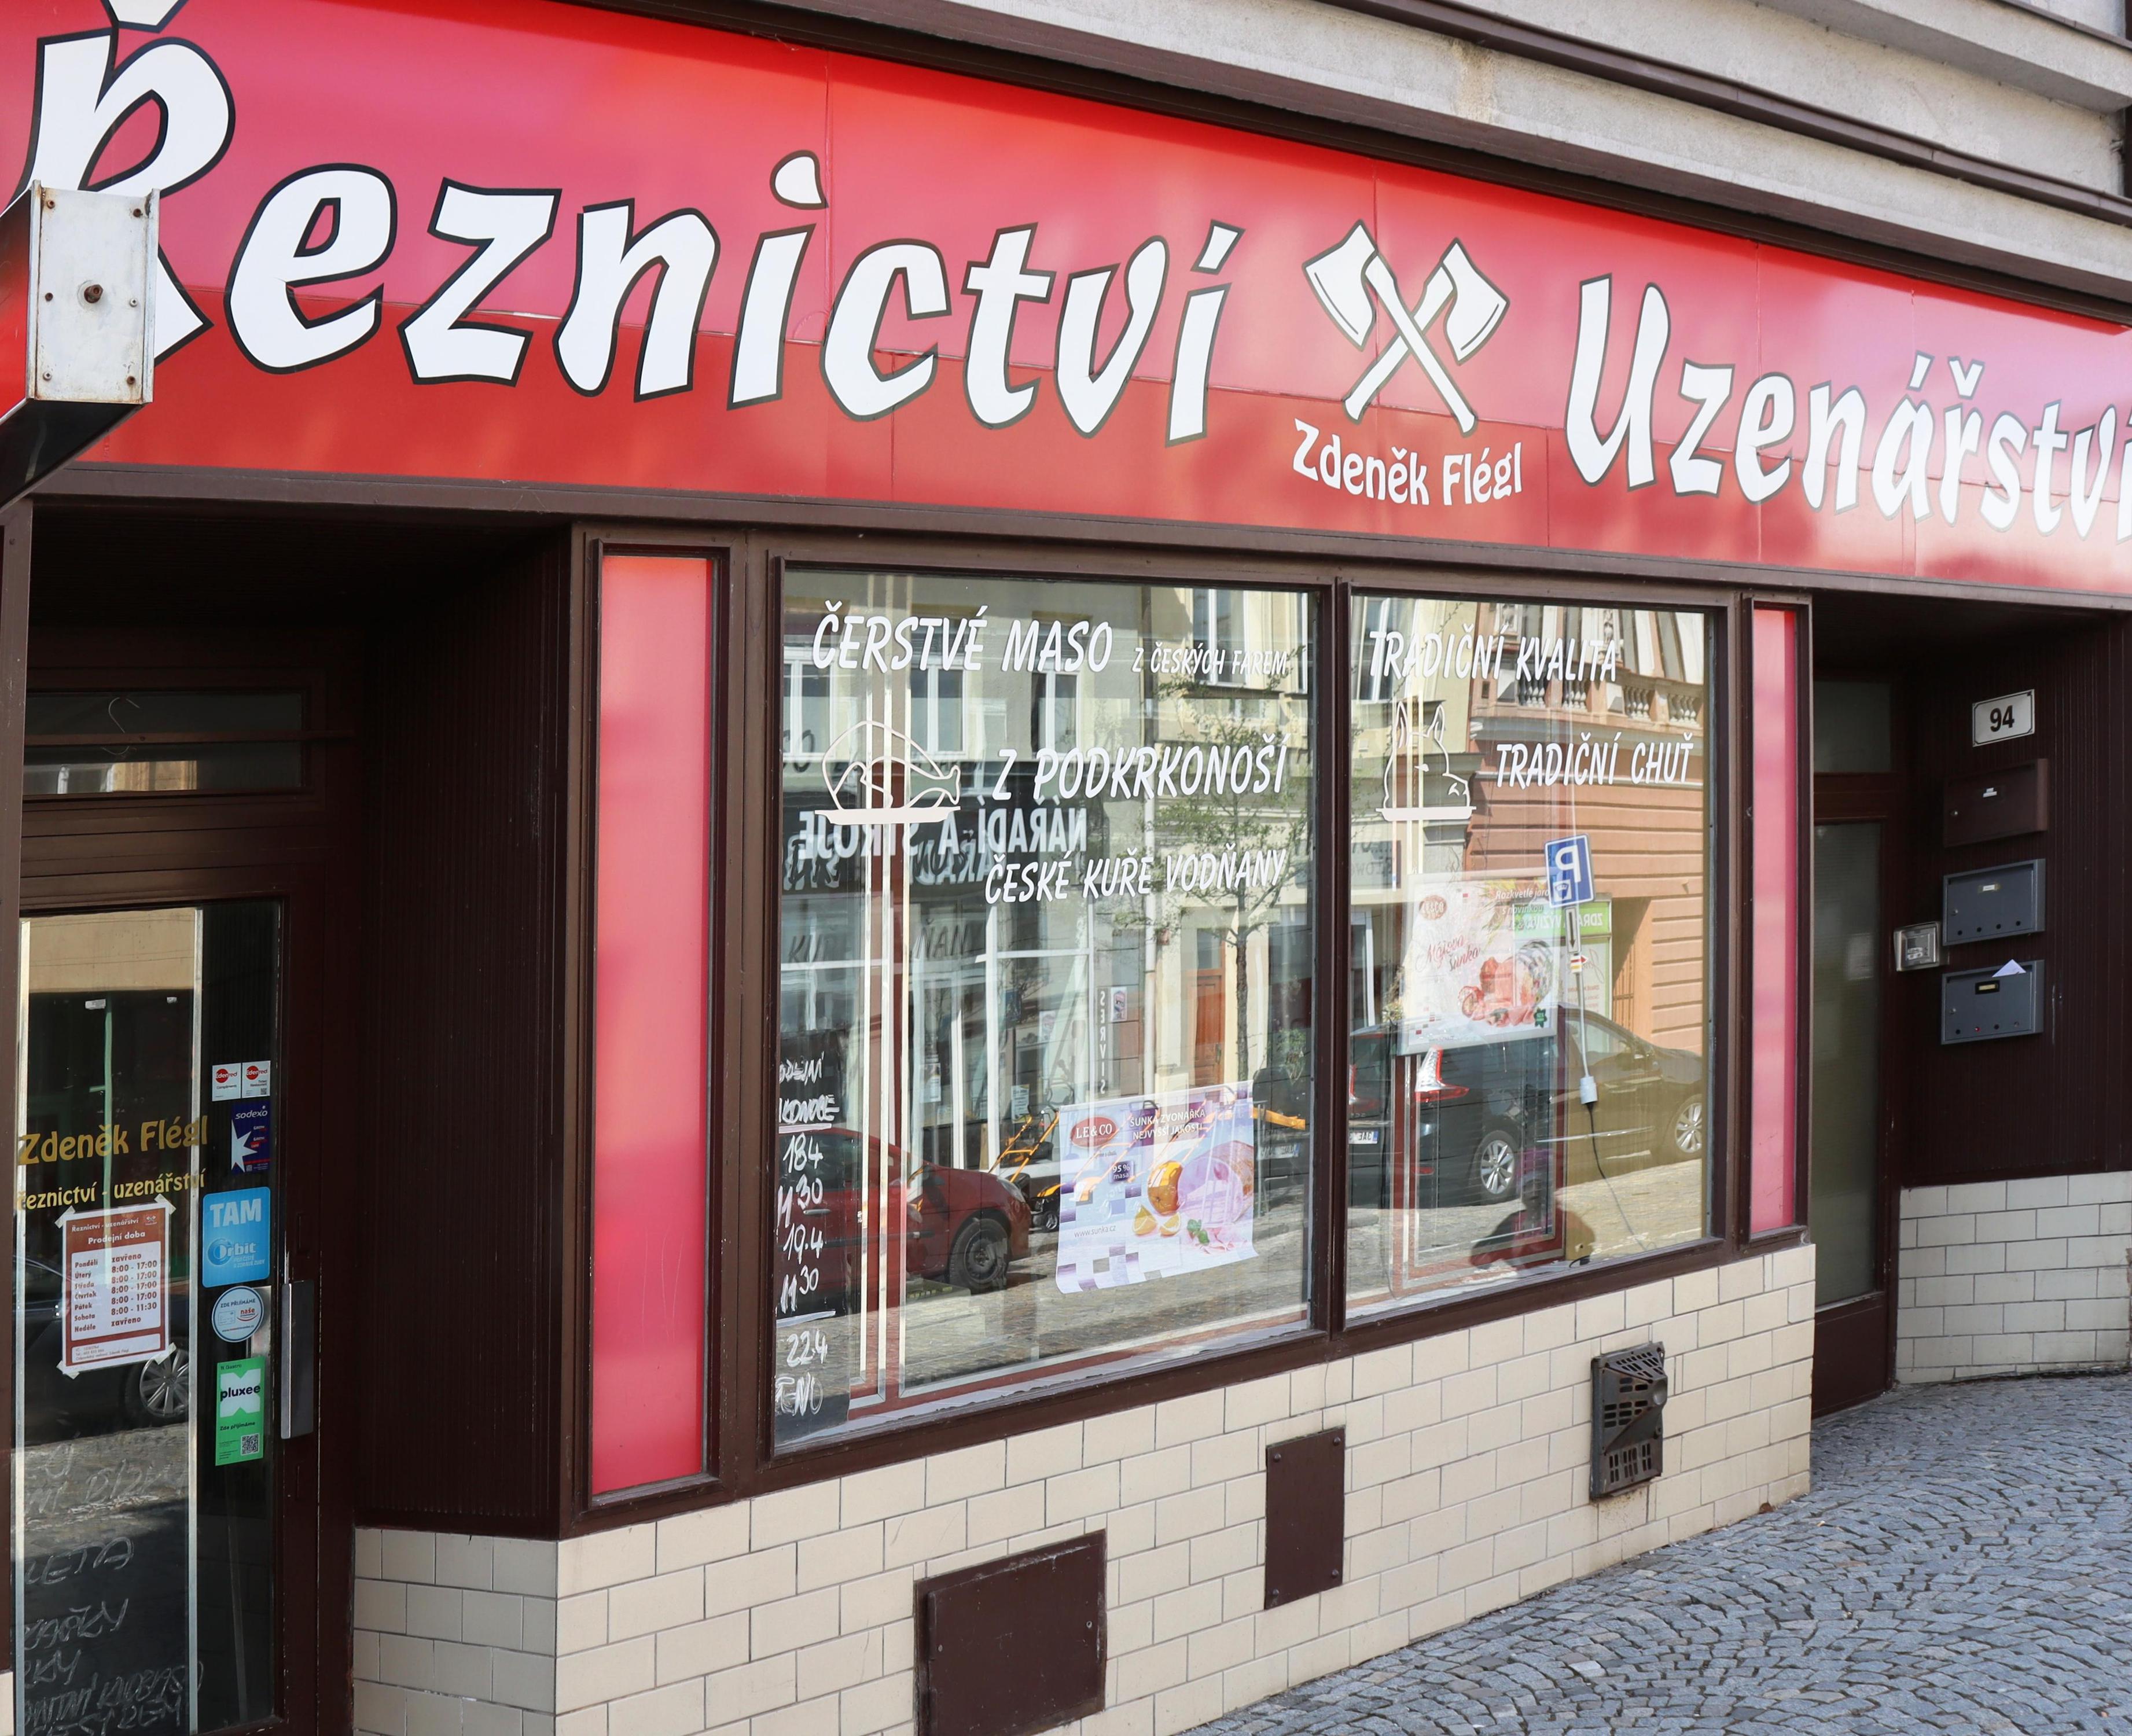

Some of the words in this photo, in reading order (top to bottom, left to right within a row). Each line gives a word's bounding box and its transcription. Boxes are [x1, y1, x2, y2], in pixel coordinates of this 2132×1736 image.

[0, 0, 1245, 447] Řeznictví
[1292, 418, 1429, 506] Zdeněk
[1443, 442, 1522, 506] Flégl
[812, 600, 988, 673] ČERSTVÉ
[1002, 620, 1113, 673] MASO
[1131, 647, 1145, 673] Z
[1150, 641, 1226, 675] ČESKÝCH
[1232, 650, 1288, 675] FAREM
[1369, 624, 1509, 680] TRADIČNÍ
[1516, 637, 1623, 682] KVALITA
[1990, 705, 2015, 733] 94
[992, 749, 1017, 801] Z
[1033, 733, 1292, 801] PODKRKONOŠÍ
[1496, 732, 1621, 789] TRADIČNÍ
[1631, 732, 1694, 784] CHUŤ
[985, 851, 1073, 904] ČESKÉ
[1082, 847, 1152, 900] KUŘE
[1164, 843, 1287, 893] VODŇANY
[1495, 888, 1532, 899] Rozkvetlé
[215, 1071, 237, 1079] Edenred
[235, 1106, 268, 1120] sodexo
[1130, 1115, 1158, 1128] ŠUNKA
[1160, 1109, 1205, 1123] ZVONAŘKA
[18, 1124, 128, 1165] Zdeněk
[141, 1116, 207, 1152] Flégl
[114, 1168, 206, 1199] uzenářství
[209, 1198, 262, 1227] TAM
[72, 1223, 101, 1232] Řeznictví
[88, 1233, 122, 1244] Prodejní
[124, 1231, 145, 1240] doba
[75, 1259, 98, 1268] Pondělí
[112, 1253, 141, 1263] zavřeno
[208, 1238, 256, 1266] Orbit
[75, 1271, 91, 1279] Úterý
[112, 1264, 128, 1273] 8:00
[137, 1260, 157, 1270] 17:00
[75, 1281, 94, 1290] Středa
[112, 1275, 128, 1284] 8:00
[137, 1271, 157, 1280] 17:00
[75, 1291, 97, 1300] Čtvrtek
[112, 1285, 128, 1294] 8:00
[137, 1281, 157, 1290] 17:00
[75, 1303, 93, 1311] Pátek
[112, 1296, 128, 1305] 8:00
[137, 1292, 157, 1301] 17:00
[111, 1307, 128, 1316] 8:00
[137, 1302, 157, 1311] 11:30
[75, 1324, 95, 1332] Neděle
[111, 1317, 141, 1327] zavřeno
[220, 1385, 261, 1402] pluxee
